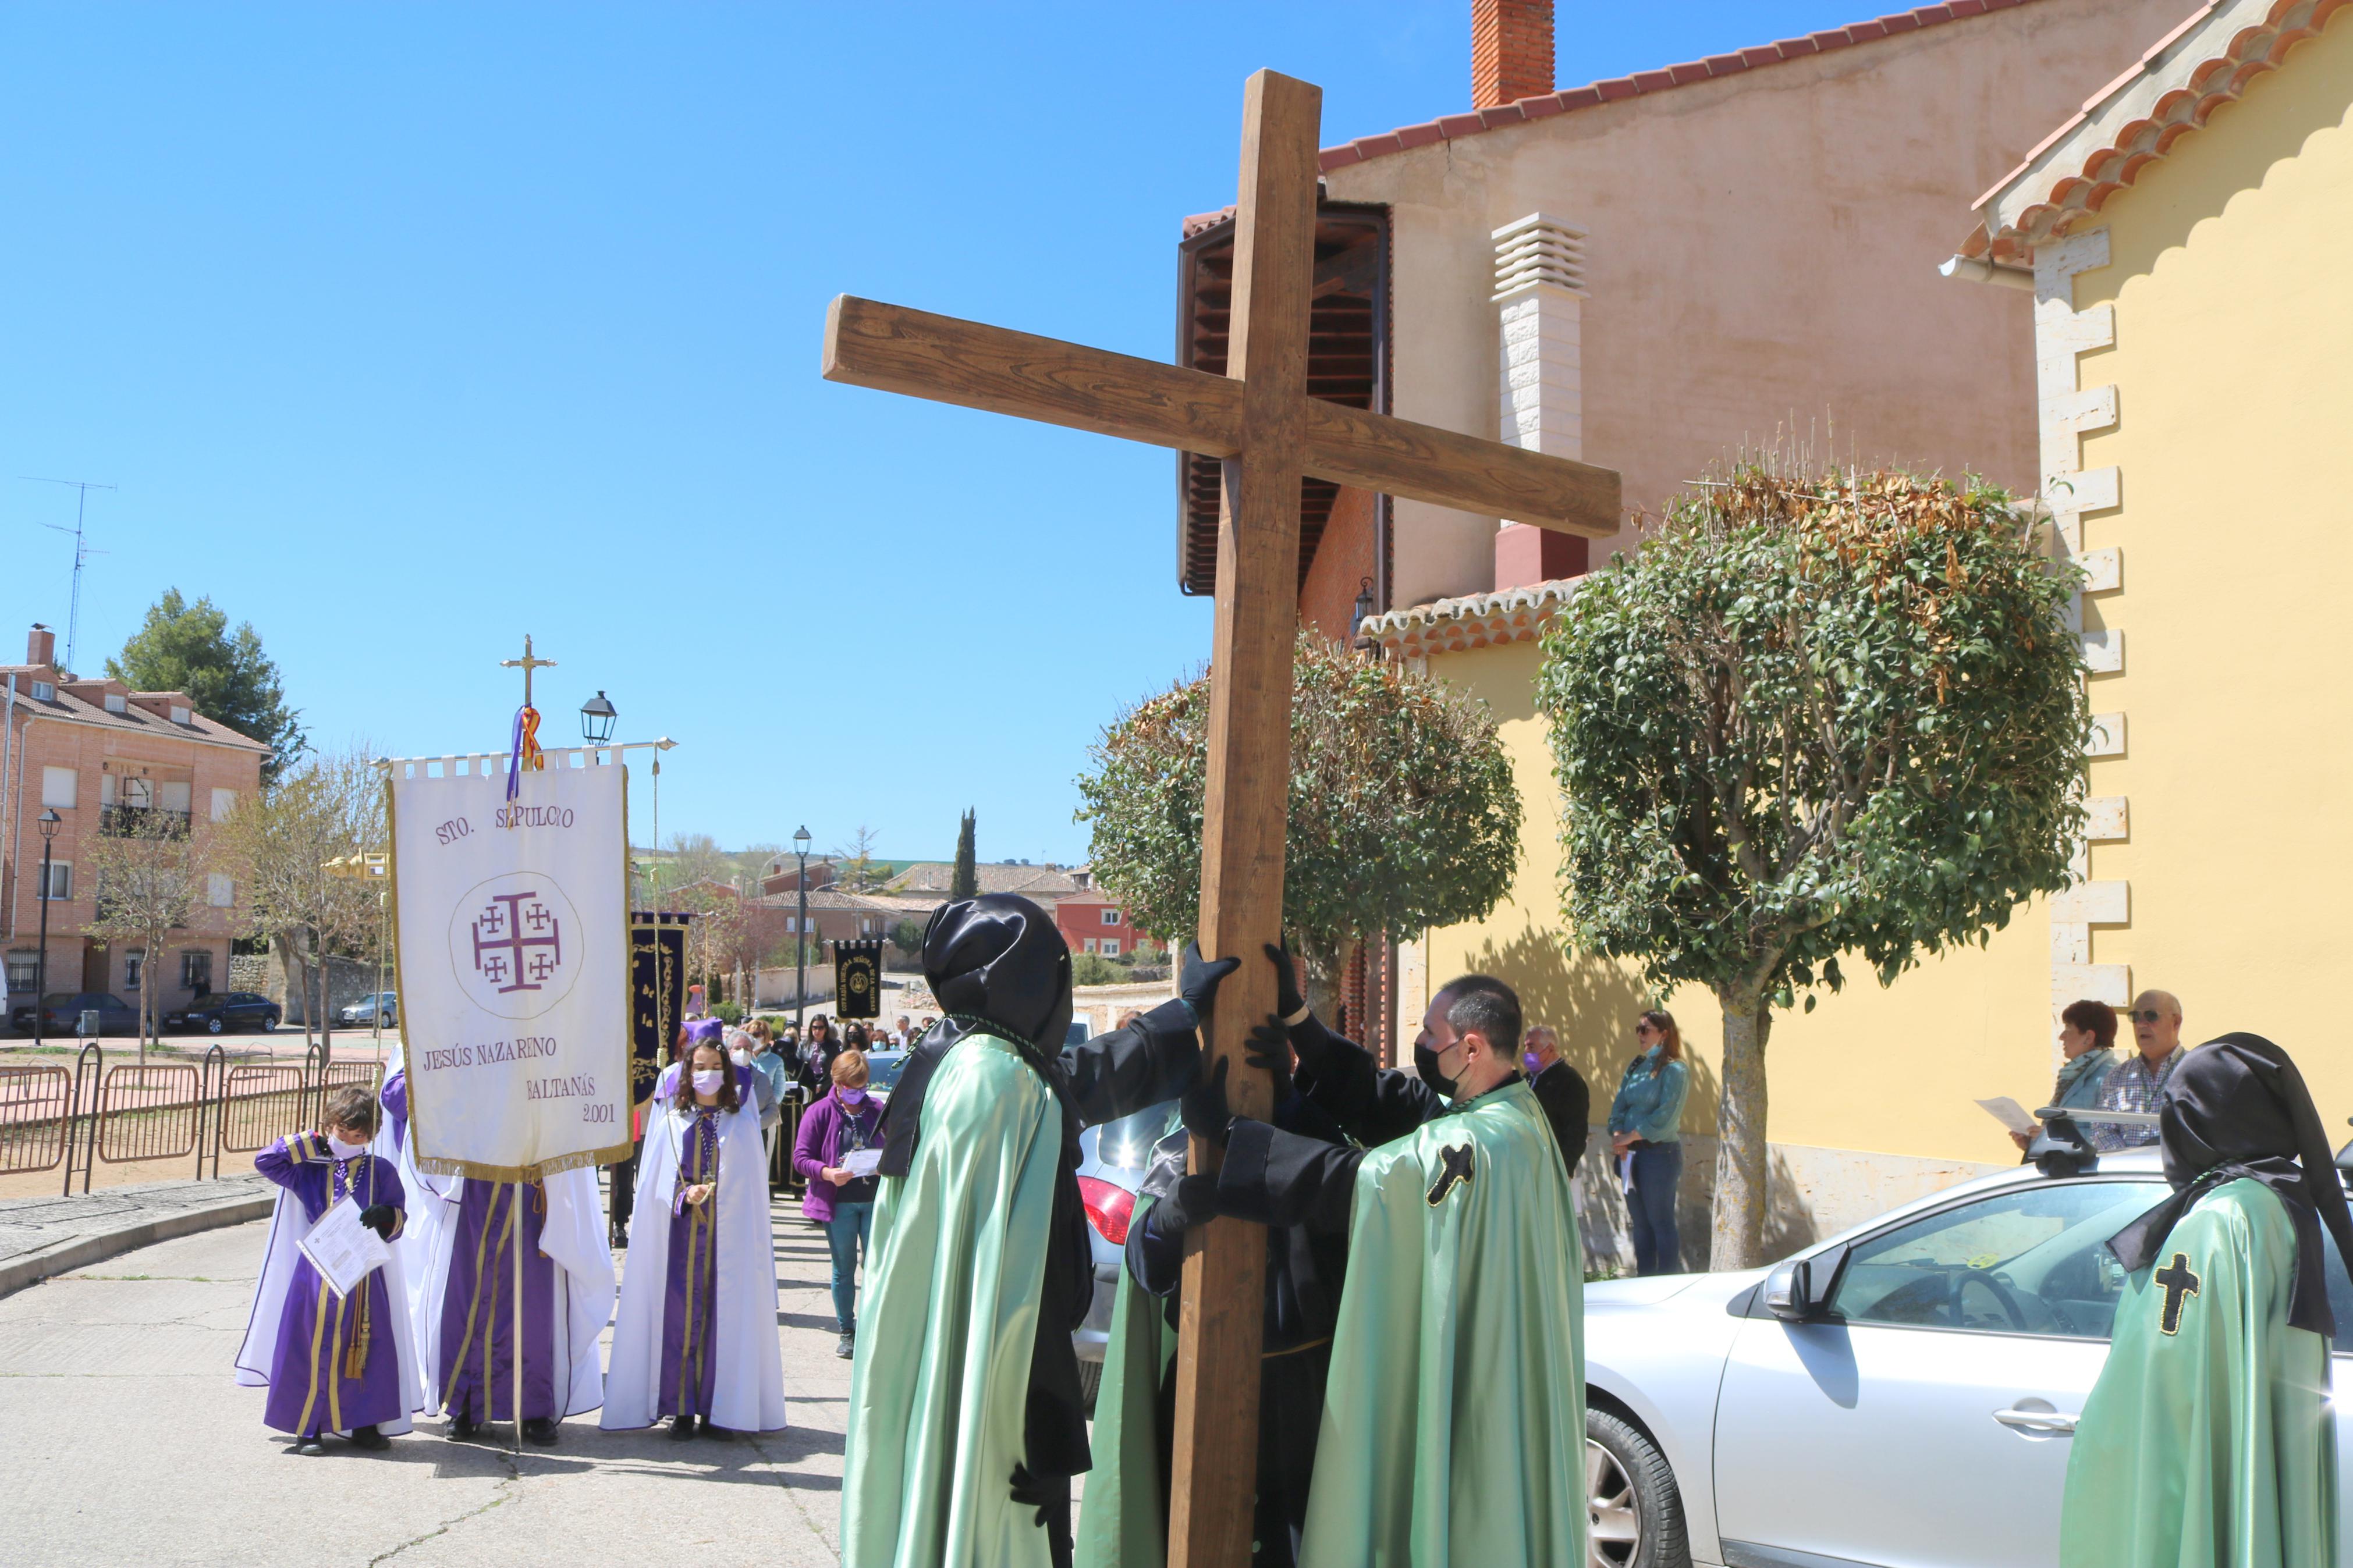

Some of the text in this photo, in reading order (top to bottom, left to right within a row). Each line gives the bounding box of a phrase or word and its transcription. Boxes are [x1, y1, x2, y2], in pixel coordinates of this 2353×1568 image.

[436, 817, 474, 846] STO.
[840, 959, 852, 983] NUESTRA
[853, 955, 872, 968] SEÑORA
[869, 969, 875, 977] DE
[642, 1013, 653, 1027] la
[424, 1037, 556, 1071] JESÚS NAZARENO
[527, 1073, 595, 1100] BALTANÁS
[583, 1104, 615, 1122] 2.001
